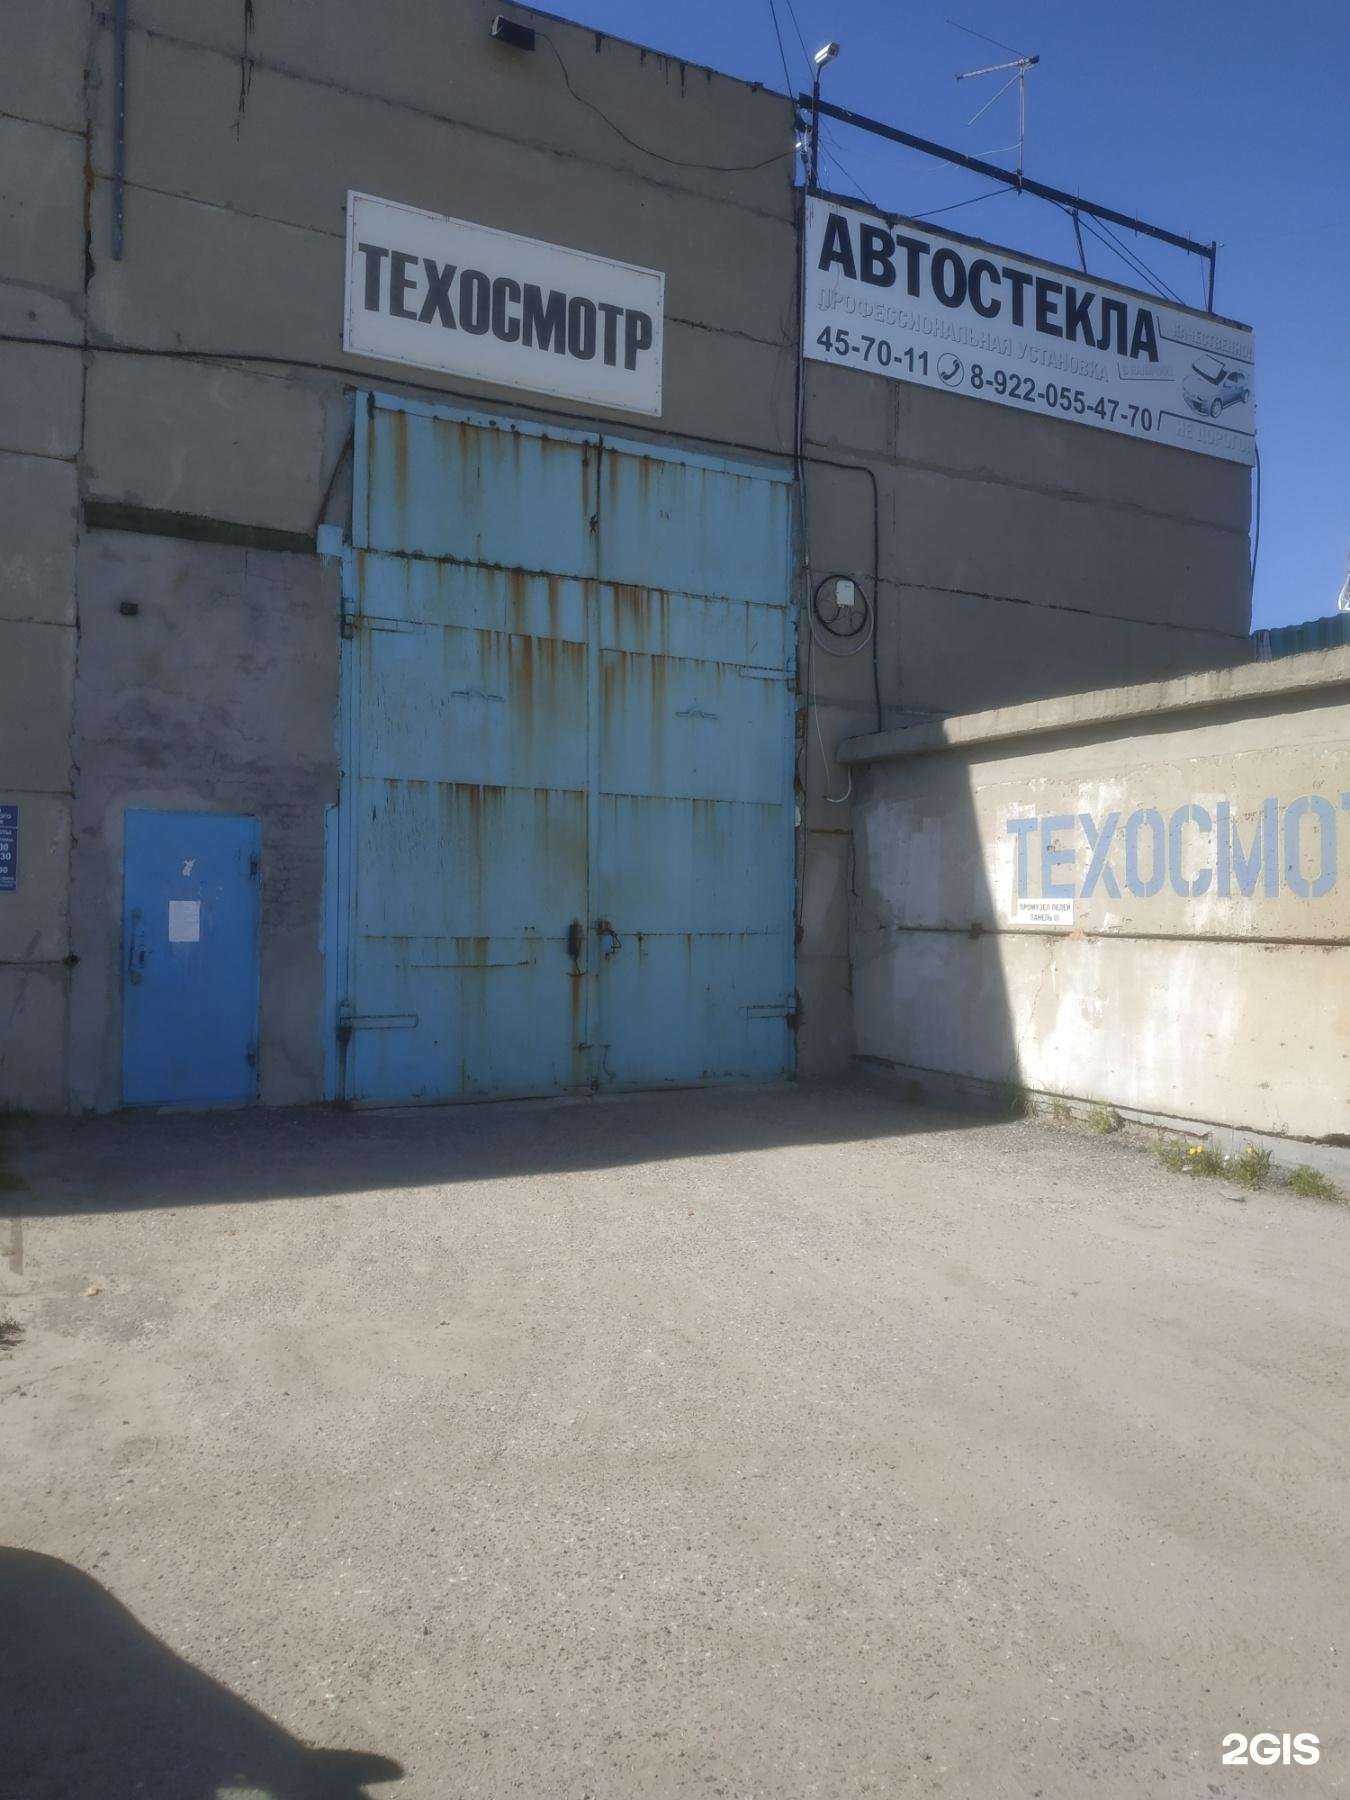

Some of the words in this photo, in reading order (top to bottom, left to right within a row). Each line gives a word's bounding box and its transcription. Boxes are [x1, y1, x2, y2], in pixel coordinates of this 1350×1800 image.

[358, 242, 653, 371] ТЕХОСМОТР
[818, 212, 1160, 363] АВТОСТЕКЛА
[816, 326, 929, 376] 45-70-11
[970, 363, 1153, 431] 8-922-055-47-70
